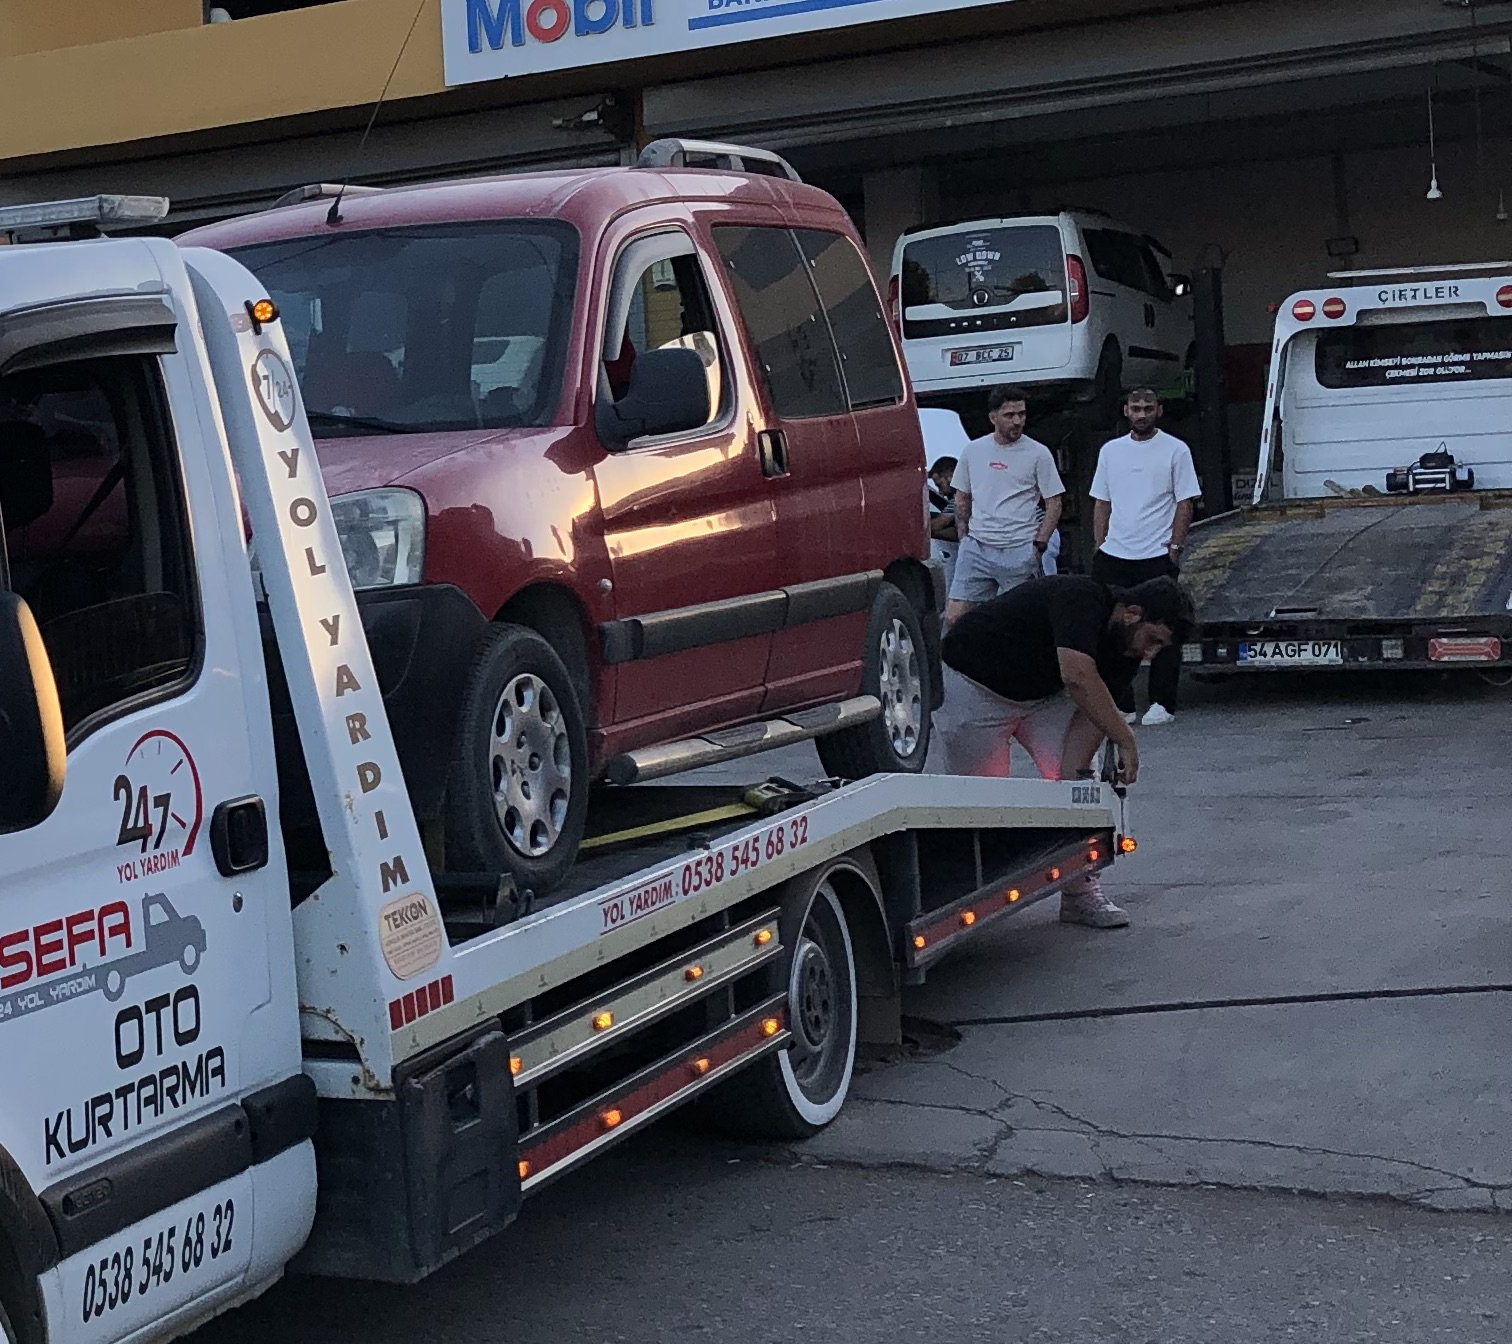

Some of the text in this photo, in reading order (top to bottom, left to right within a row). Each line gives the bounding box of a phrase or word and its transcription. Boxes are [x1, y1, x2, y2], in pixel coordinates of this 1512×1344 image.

[277, 447, 327, 577] YOL
[1248, 641, 1341, 659] 54 AGF 071
[319, 614, 410, 893] YARDIM
[116, 848, 181, 884] YOL YARDIM
[602, 902, 625, 927] YOL
[681, 851, 725, 897] 0538
[729, 836, 760, 878] 545
[765, 826, 785, 860] 68
[789, 815, 809, 849] 32
[17, 991, 45, 1011] YOL
[49, 973, 97, 1001] YARDIM
[113, 983, 201, 1071] OTO
[45, 1045, 226, 1165] KURTARMA
[82, 1198, 235, 1324] 0538 545 68 32
